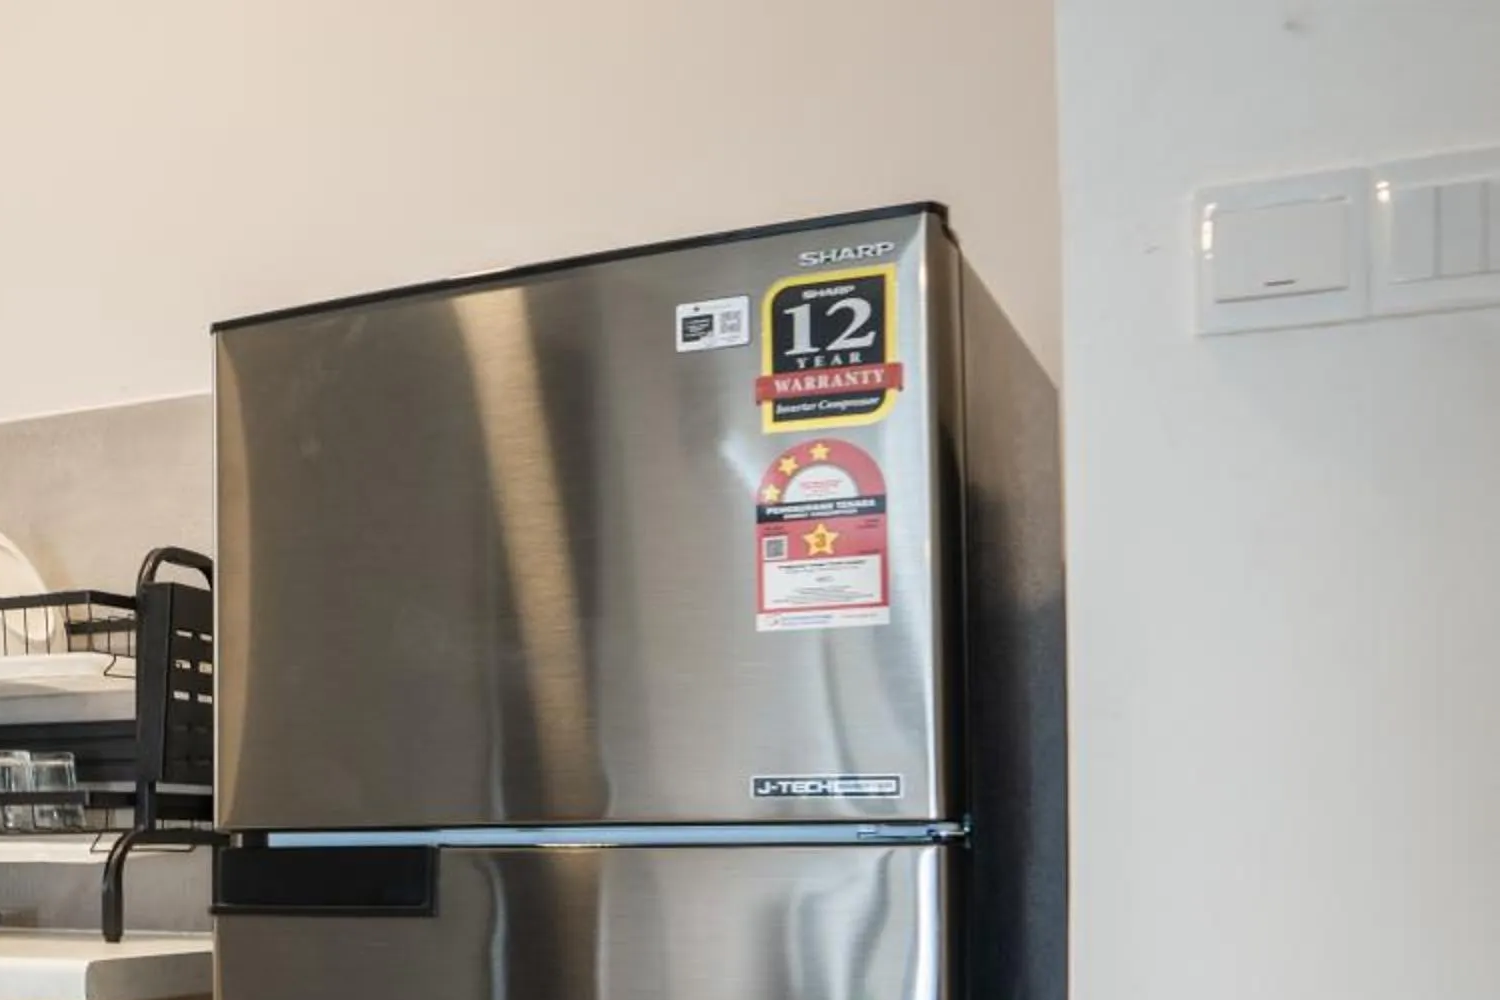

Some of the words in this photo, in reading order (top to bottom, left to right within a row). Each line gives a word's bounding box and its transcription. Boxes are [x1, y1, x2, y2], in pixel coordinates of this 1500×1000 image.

[799, 242, 895, 266] SHARP
[802, 285, 855, 299] SHARP
[784, 298, 876, 356] 12
[796, 352, 863, 369] YEAR
[774, 369, 885, 394] WARRANTY
[814, 533, 827, 549] 3
[757, 781, 832, 795] J-TECH
